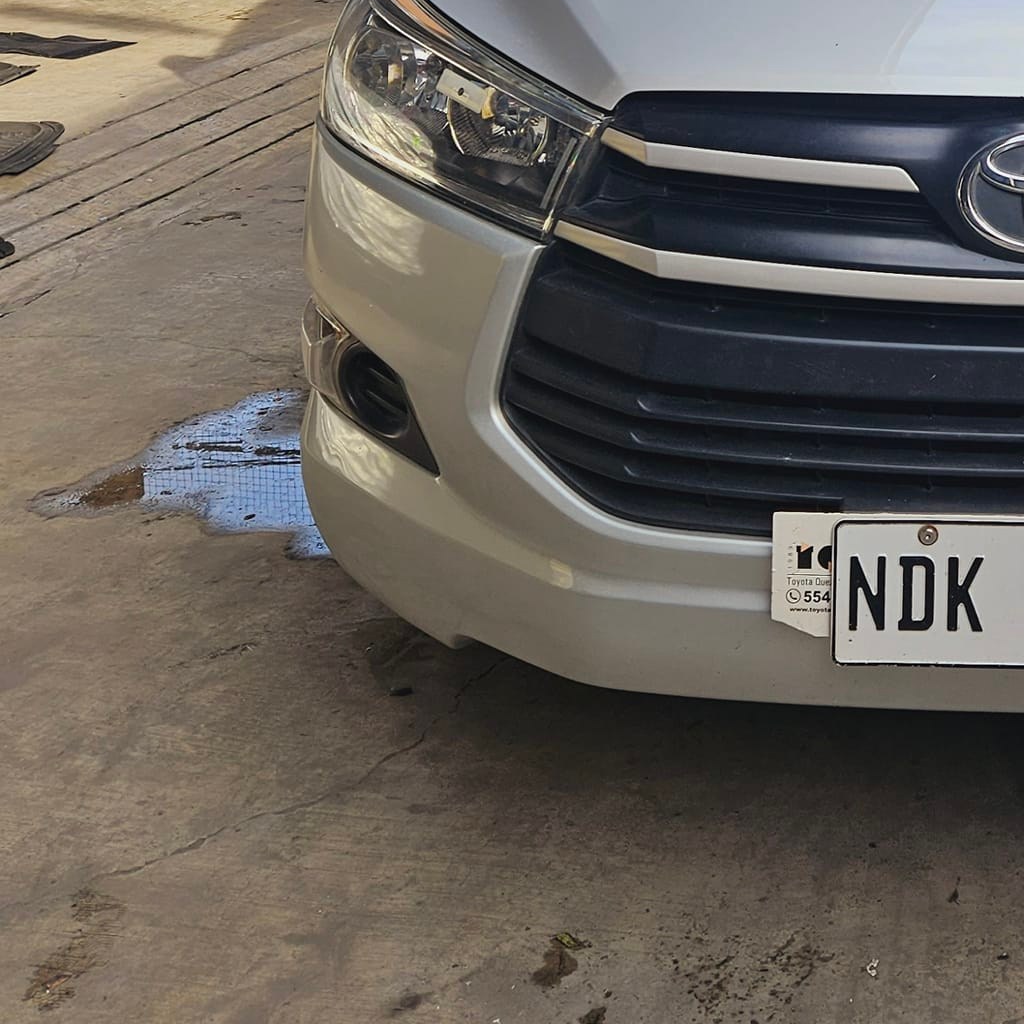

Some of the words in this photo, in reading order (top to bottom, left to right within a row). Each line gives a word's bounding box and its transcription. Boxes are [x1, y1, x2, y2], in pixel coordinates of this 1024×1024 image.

[787, 576, 813, 587] Toyota
[803, 590, 831, 603] 554
[848, 556, 984, 632] NDK
